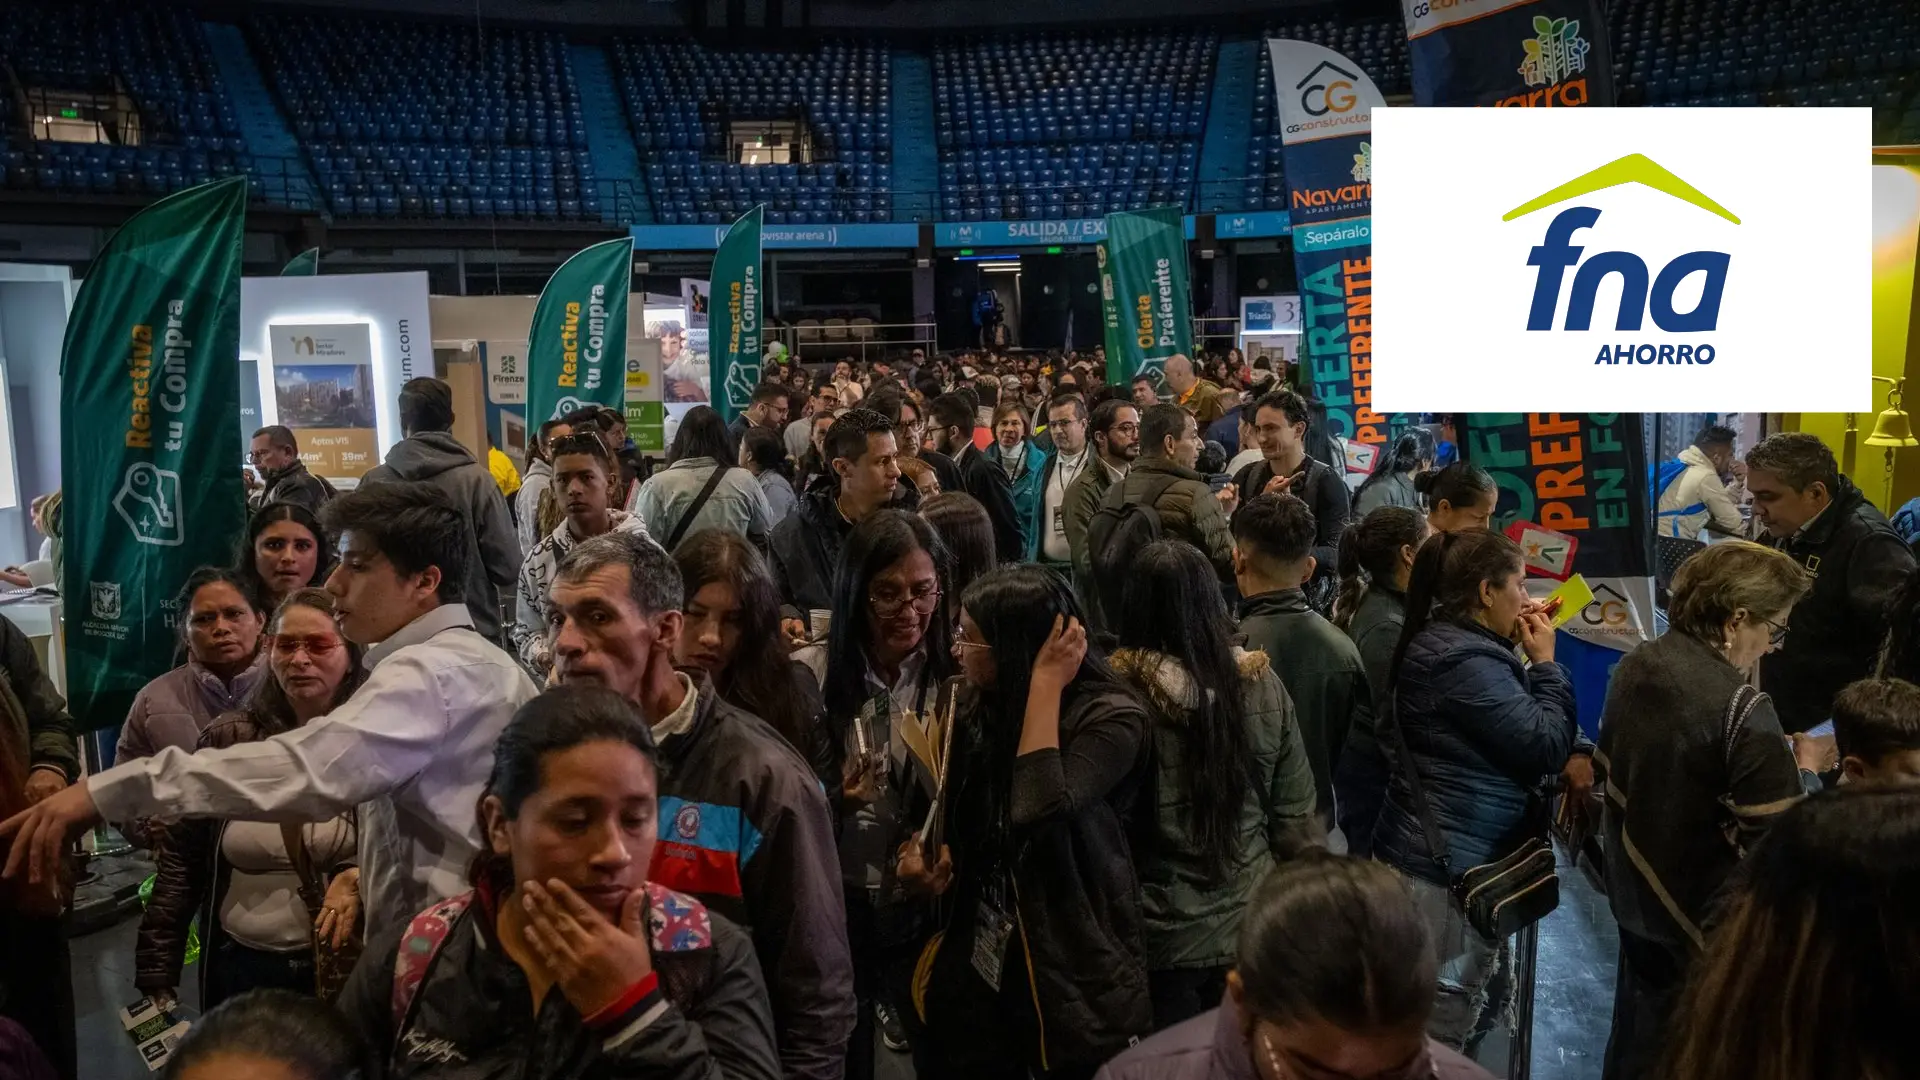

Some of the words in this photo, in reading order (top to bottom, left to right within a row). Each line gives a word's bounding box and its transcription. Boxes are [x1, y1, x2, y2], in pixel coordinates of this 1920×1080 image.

[1301, 81, 1357, 117] CG
[1473, 78, 1588, 107] arra
[1008, 221, 1069, 237] SALIDA
[1082, 220, 1107, 235] EXI
[1305, 200, 1371, 214] APARTAMENT
[761, 231, 794, 240] ovistar
[796, 231, 825, 240] arena
[728, 281, 741, 353] Reactiva
[741, 265, 758, 332] Compra
[1152, 258, 1176, 347] Preferente
[583, 284, 609, 363] Compra
[1136, 295, 1154, 348] Oferta
[159, 299, 191, 413] Compra
[558, 302, 580, 387] Reactiva
[743, 336, 758, 354] tu
[1303, 261, 1355, 440] OFERTA
[126, 324, 152, 448] Reactiva
[493, 375, 525, 383] Firenze
[584, 368, 601, 389] tu
[164, 421, 184, 451] tu
[1593, 468, 1629, 528] EN
[1581, 601, 1628, 625] CG
